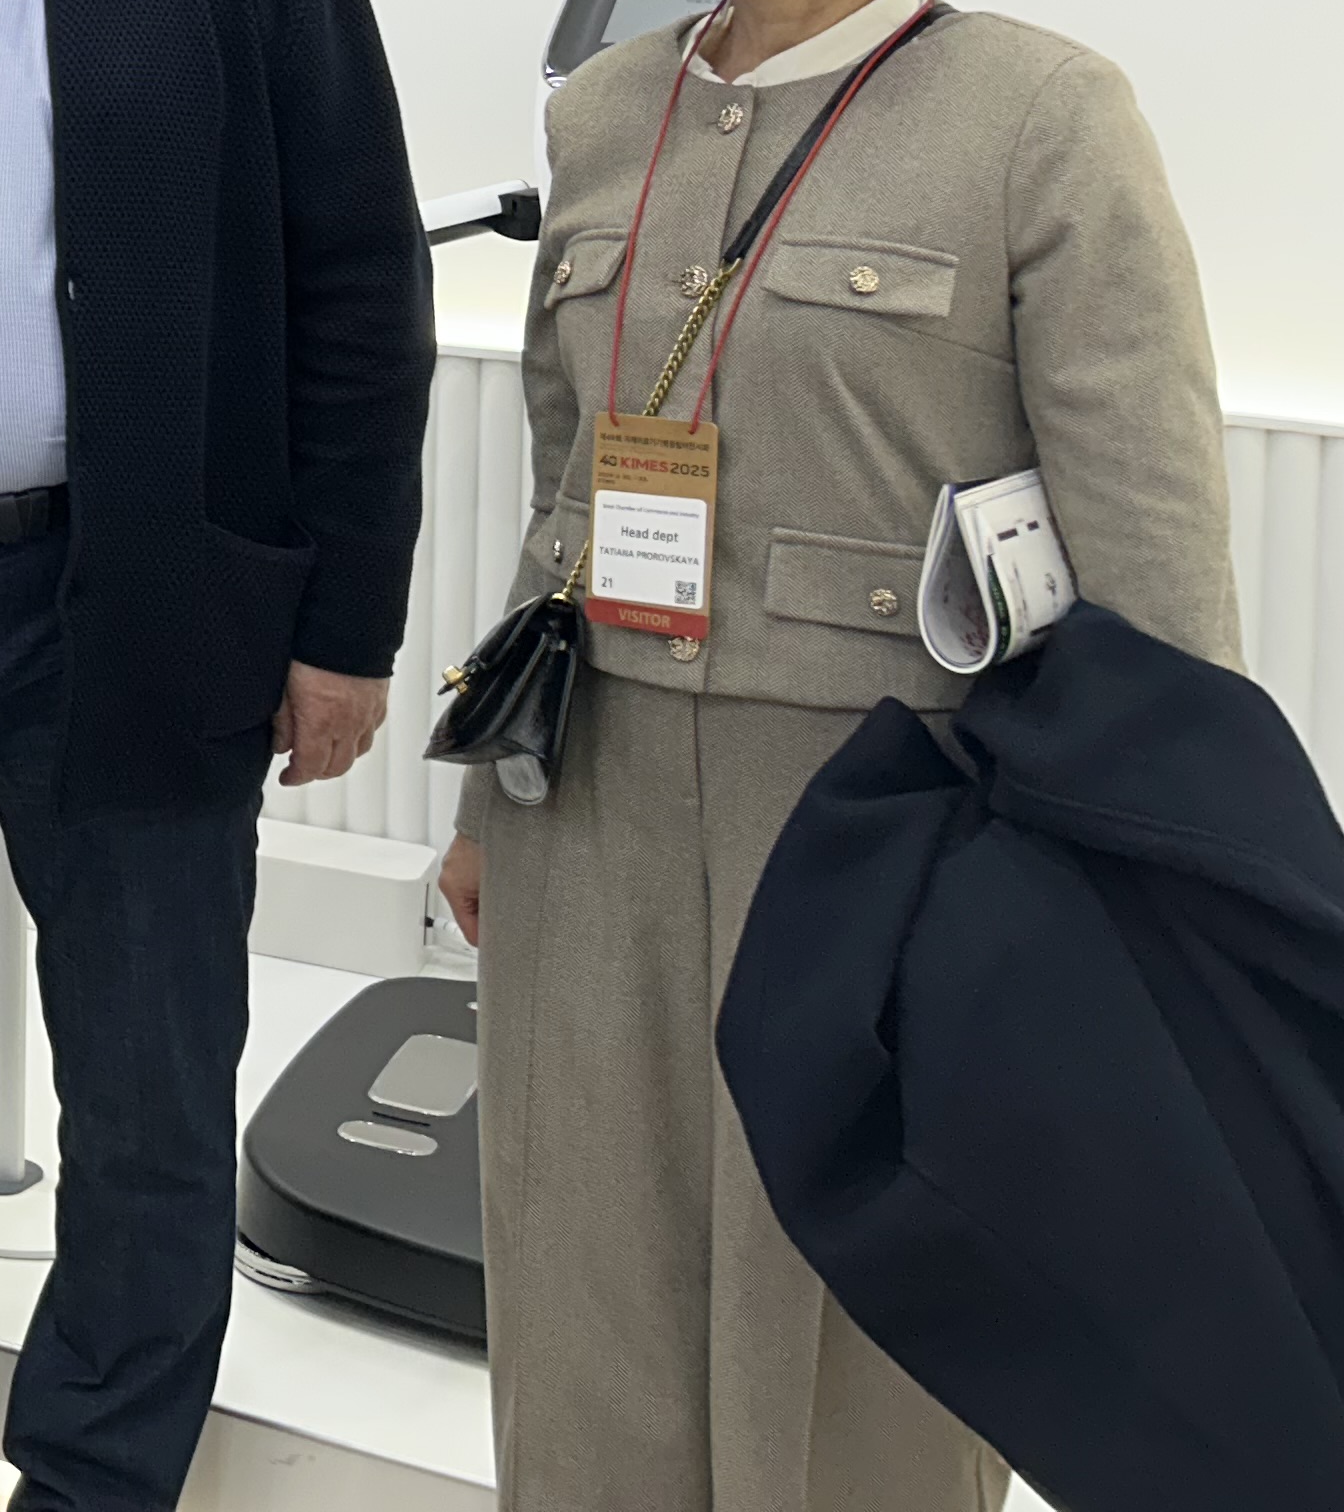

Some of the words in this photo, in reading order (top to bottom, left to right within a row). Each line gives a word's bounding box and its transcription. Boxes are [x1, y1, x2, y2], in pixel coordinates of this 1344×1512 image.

[619, 455, 669, 473] KIMES
[670, 462, 710, 478] 2025
[620, 526, 649, 540] Head
[652, 529, 679, 544] dept
[601, 576, 613, 588] 21
[618, 607, 672, 629] VISITOR
